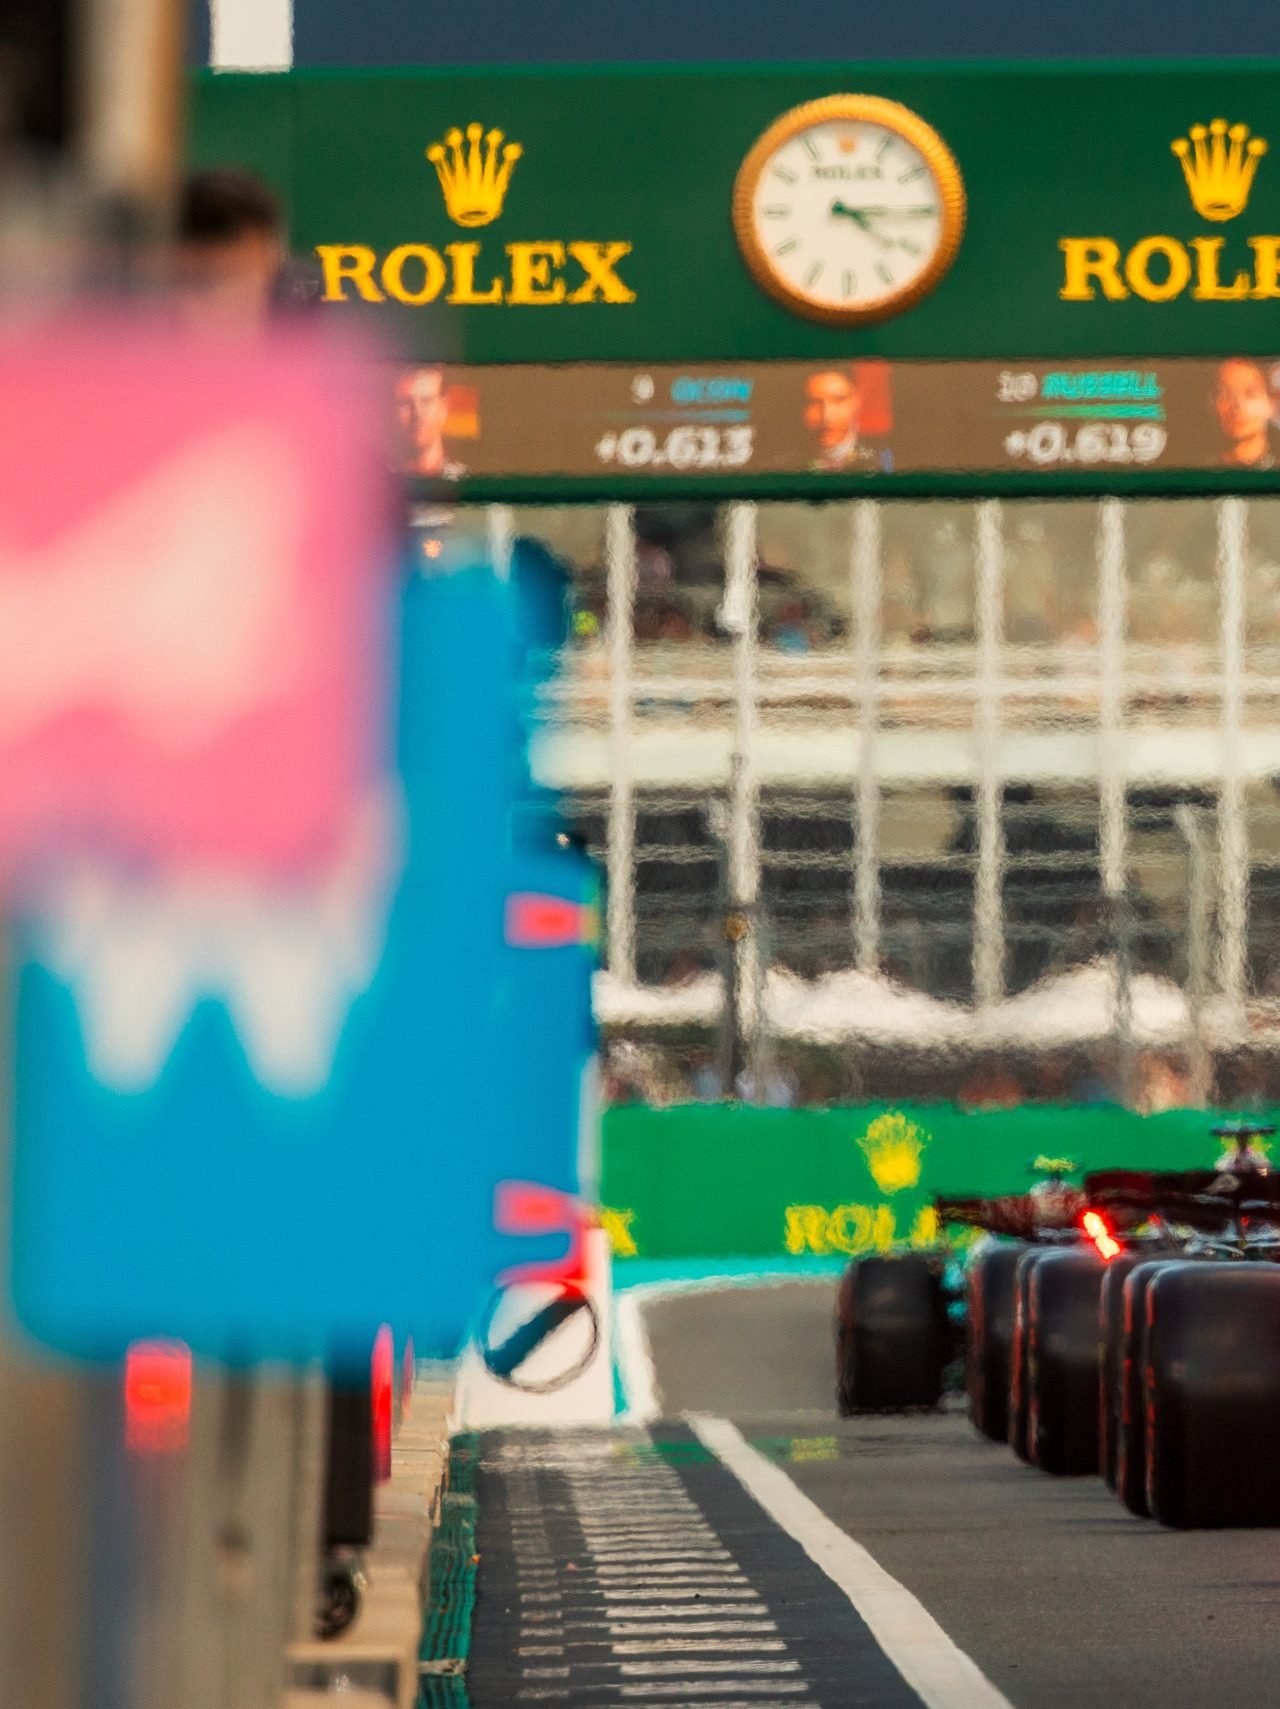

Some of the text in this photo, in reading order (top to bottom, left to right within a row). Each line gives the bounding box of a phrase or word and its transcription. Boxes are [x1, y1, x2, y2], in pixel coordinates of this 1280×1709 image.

[315, 241, 637, 306] ROLEX
[1041, 371, 1165, 400] RUSSELL
[1003, 421, 1168, 465] +0.619
